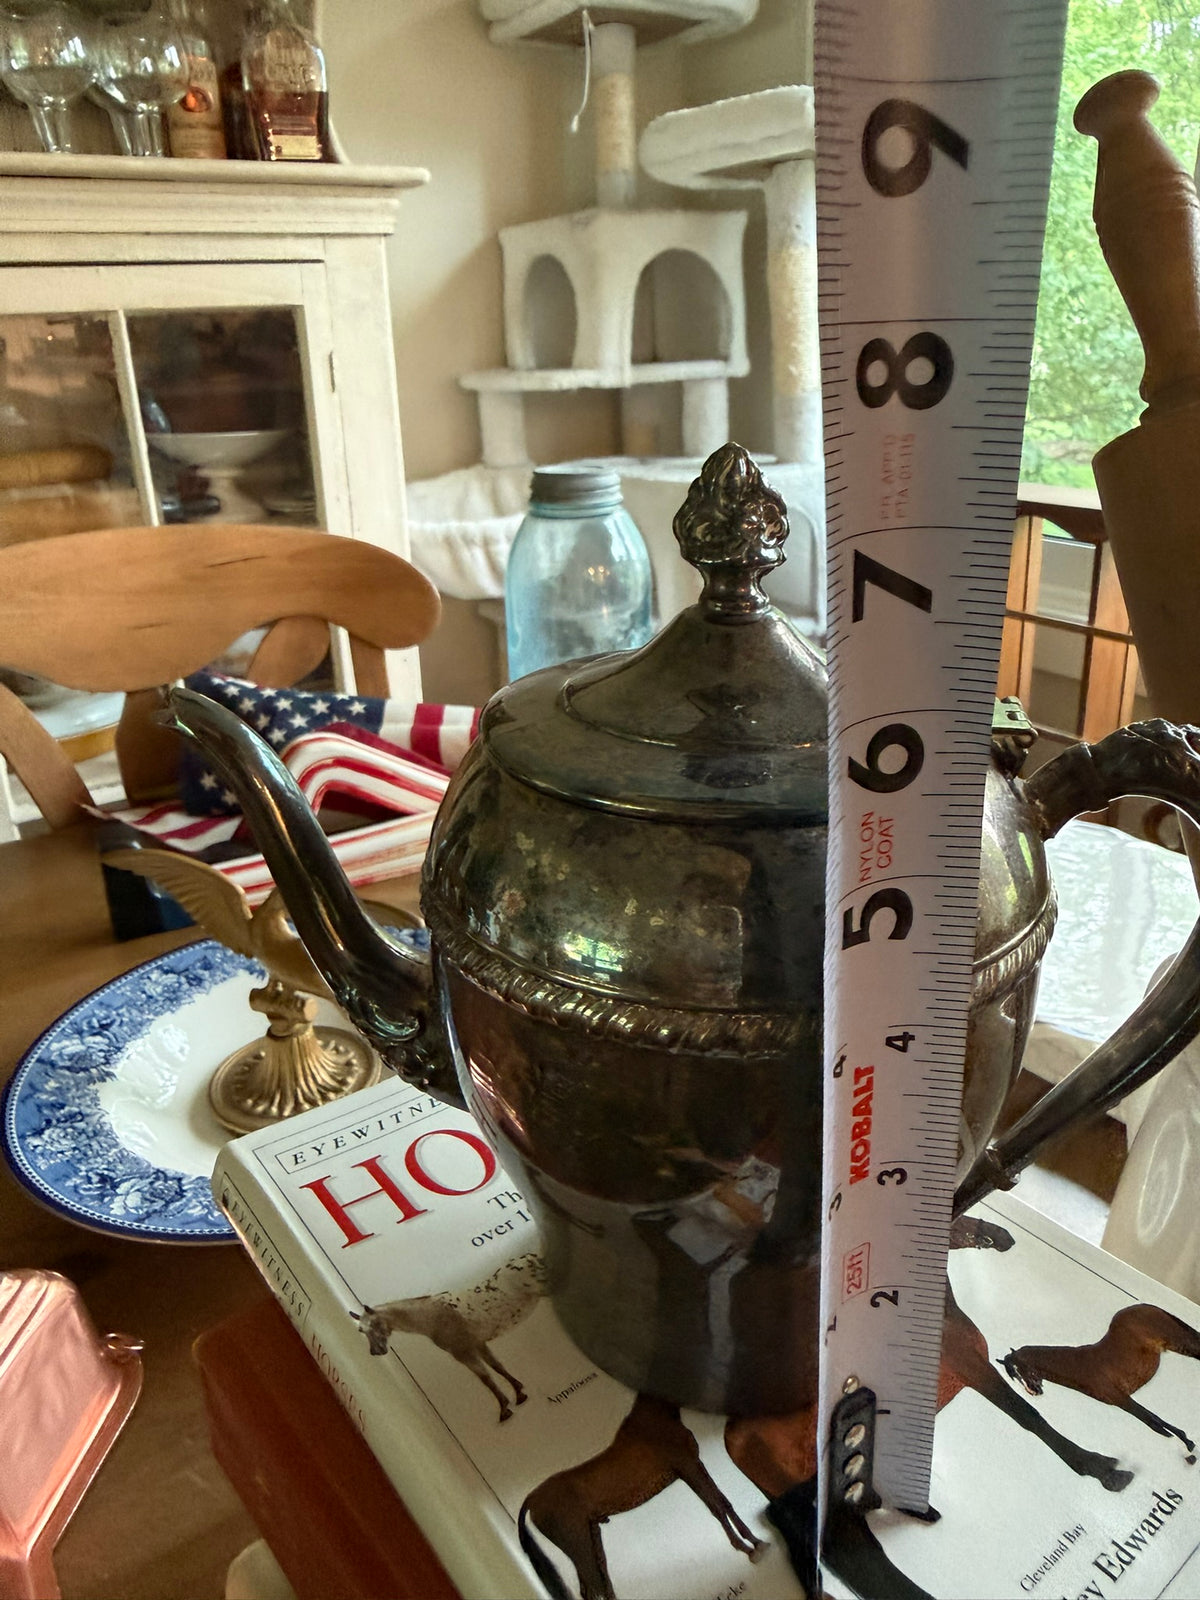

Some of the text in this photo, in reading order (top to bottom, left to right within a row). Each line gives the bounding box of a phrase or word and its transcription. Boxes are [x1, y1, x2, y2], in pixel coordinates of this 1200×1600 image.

[861, 98, 969, 198] 9
[856, 331, 954, 411] 8
[852, 549, 932, 623] 7
[848, 723, 924, 793] 6
[859, 811, 875, 882] NYLON
[877, 816, 894, 869] COAT
[842, 888, 913, 950] 5
[885, 1031, 915, 1053] 4
[850, 1065, 874, 1185] KOBALT
[877, 1168, 907, 1186] 3
[471, 1220, 514, 1247] over
[870, 1290, 898, 1308] 2
[1019, 1539, 1069, 1592] Cleveland
[1063, 1523, 1088, 1545] Bay
[1091, 1488, 1184, 1583] Edwards
